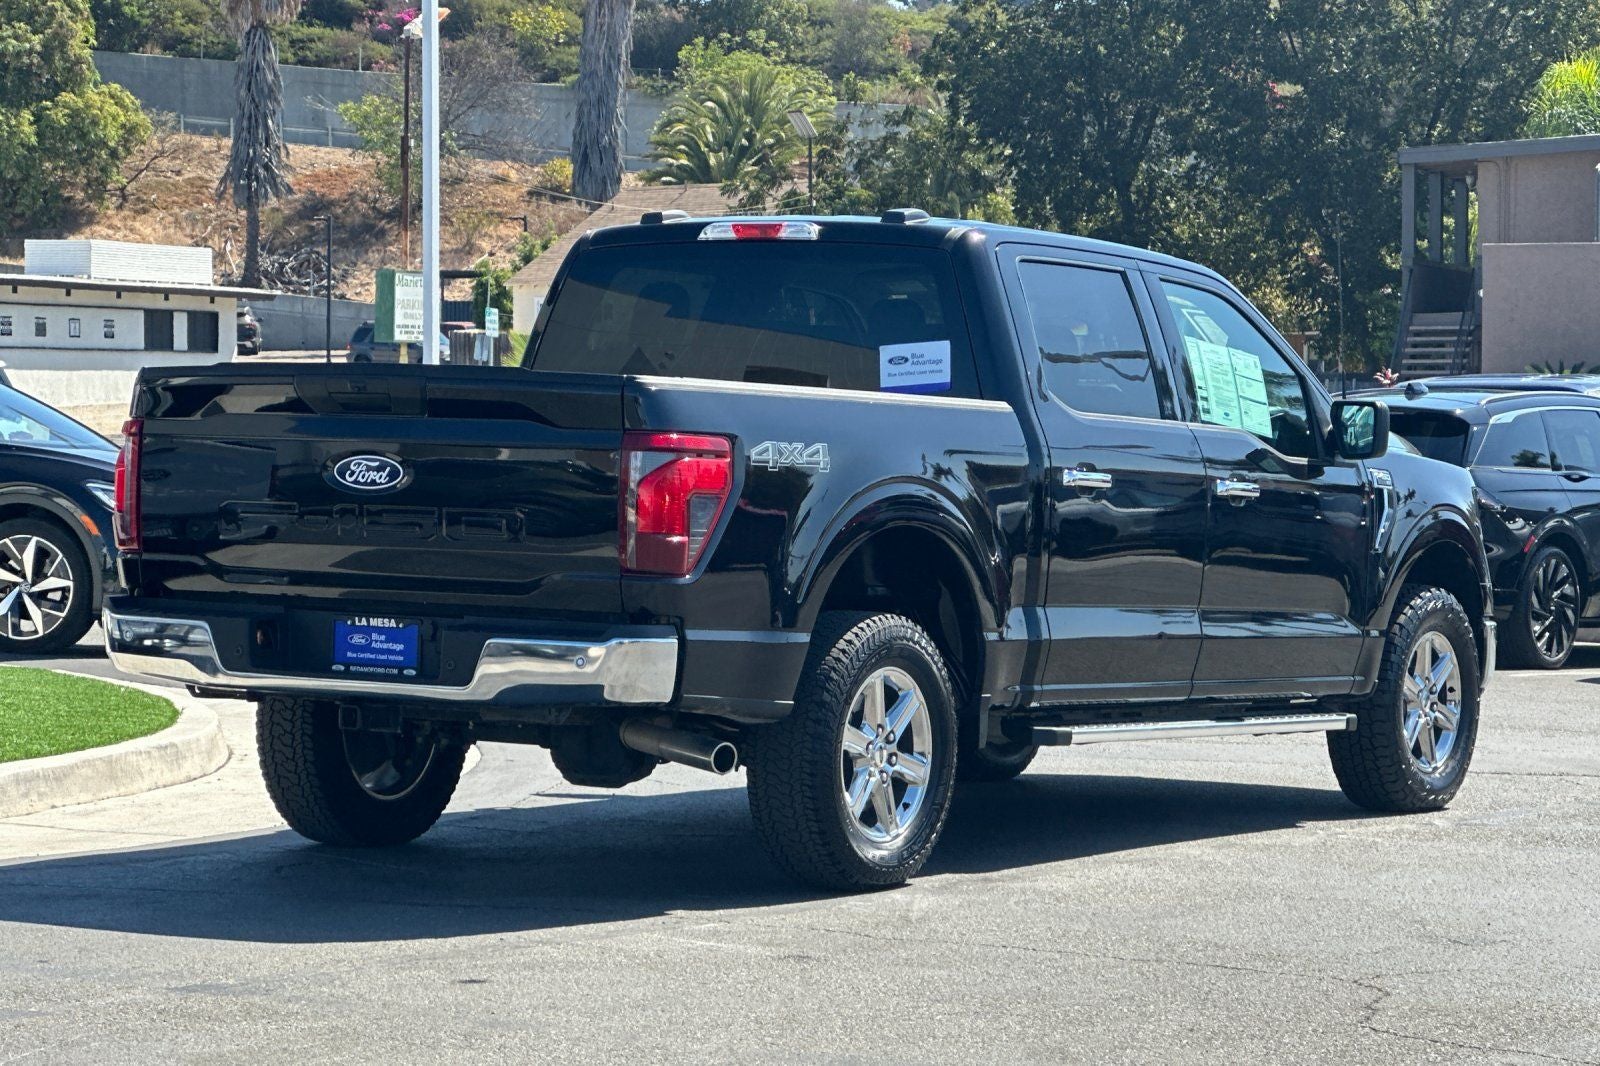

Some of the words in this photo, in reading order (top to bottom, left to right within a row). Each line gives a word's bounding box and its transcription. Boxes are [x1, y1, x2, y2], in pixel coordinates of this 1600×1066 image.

[397, 275, 423, 288] Mariet
[397, 299, 423, 310] PARKI
[344, 459, 390, 484] Ford
[355, 617, 367, 626] LA
[369, 618, 397, 628] MESA
[371, 633, 386, 641] Blue
[371, 641, 405, 651] Advantage
